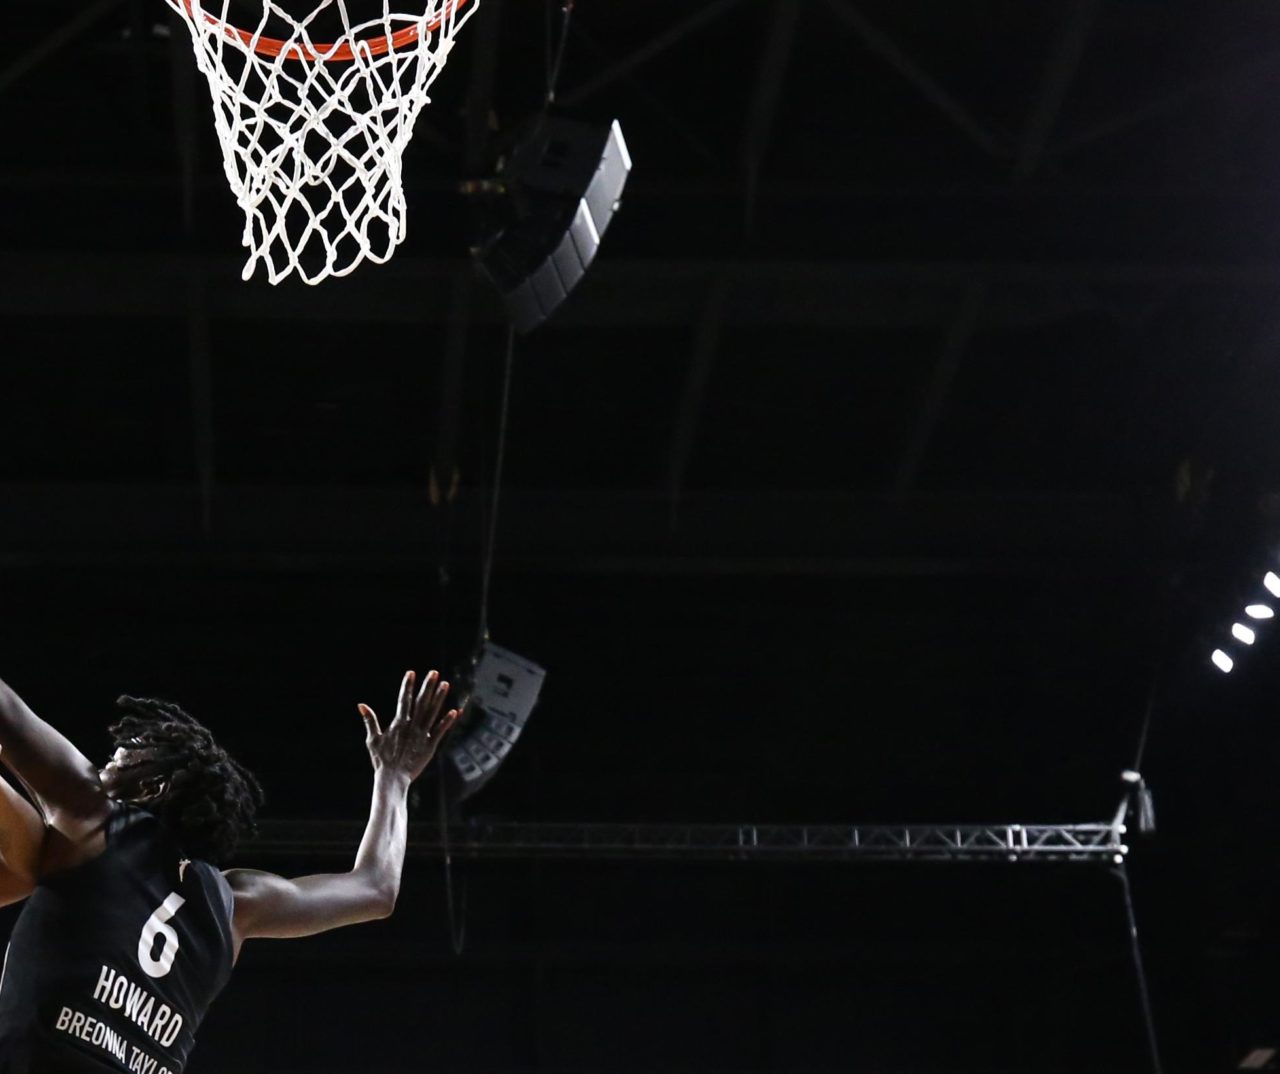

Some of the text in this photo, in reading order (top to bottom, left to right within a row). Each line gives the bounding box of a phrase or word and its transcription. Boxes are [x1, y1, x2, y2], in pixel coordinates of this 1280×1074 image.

[137, 891, 186, 979] 6
[55, 1006, 128, 1065] BREONNA
[92, 965, 184, 1048] HOWARD
